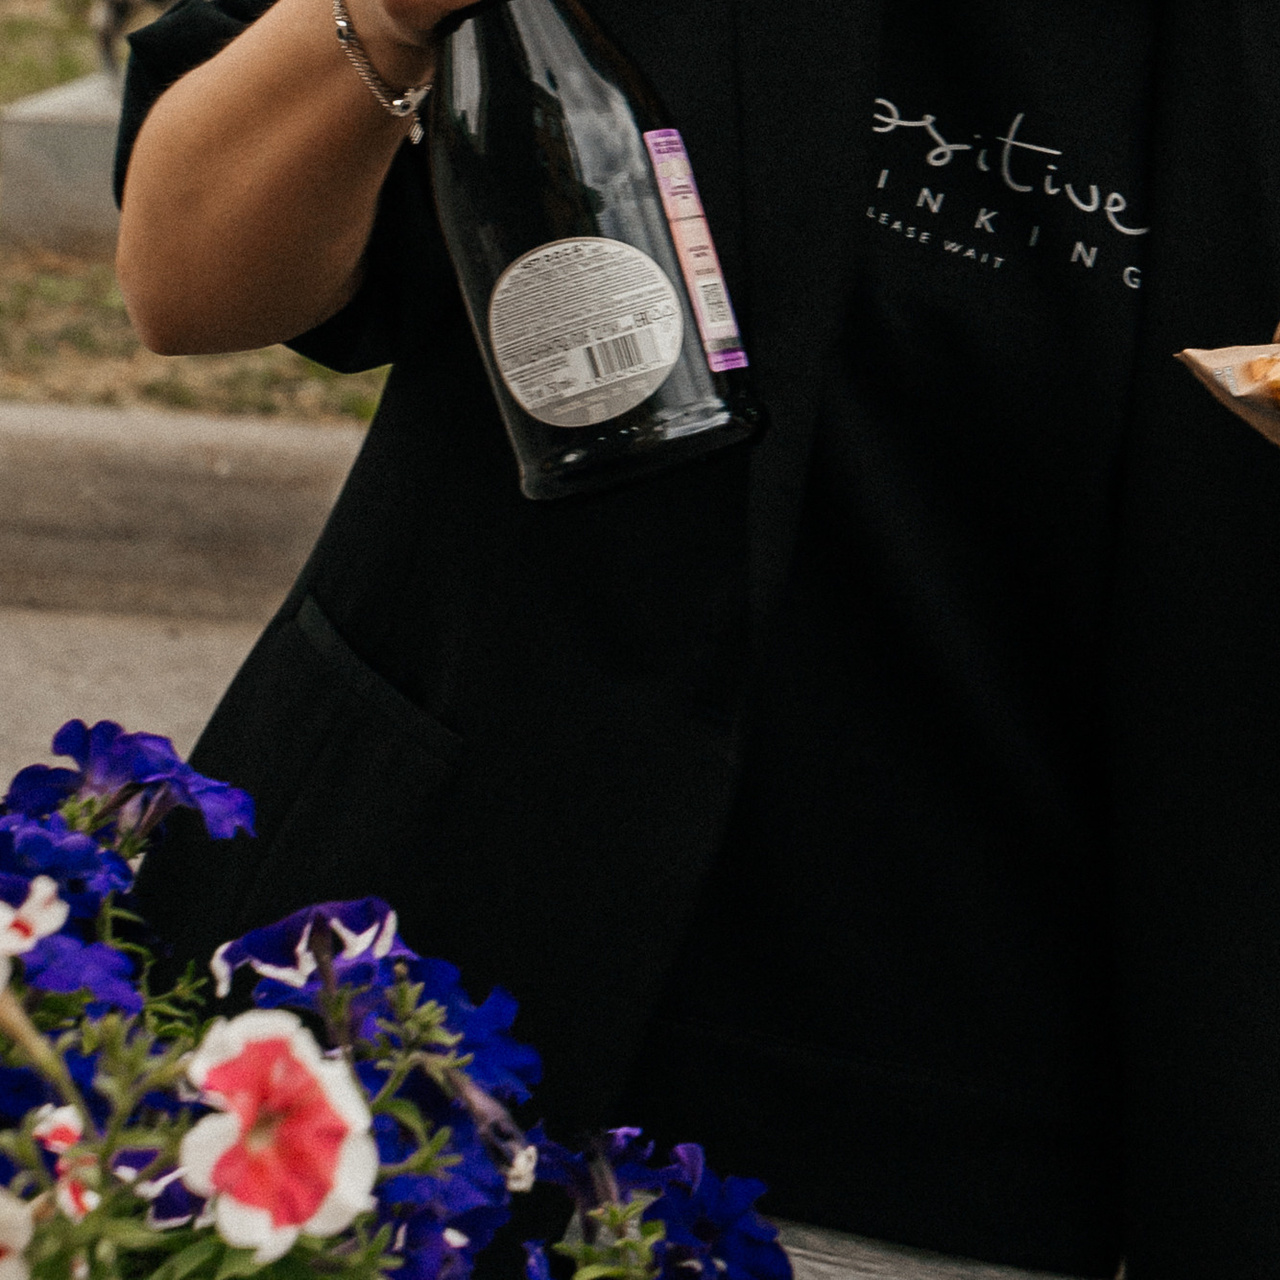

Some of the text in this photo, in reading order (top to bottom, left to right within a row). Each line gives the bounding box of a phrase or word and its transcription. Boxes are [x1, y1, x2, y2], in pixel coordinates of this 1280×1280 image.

[866, 206, 1006, 269] LEASE WAIT
[876, 168, 1142, 289] INKING
